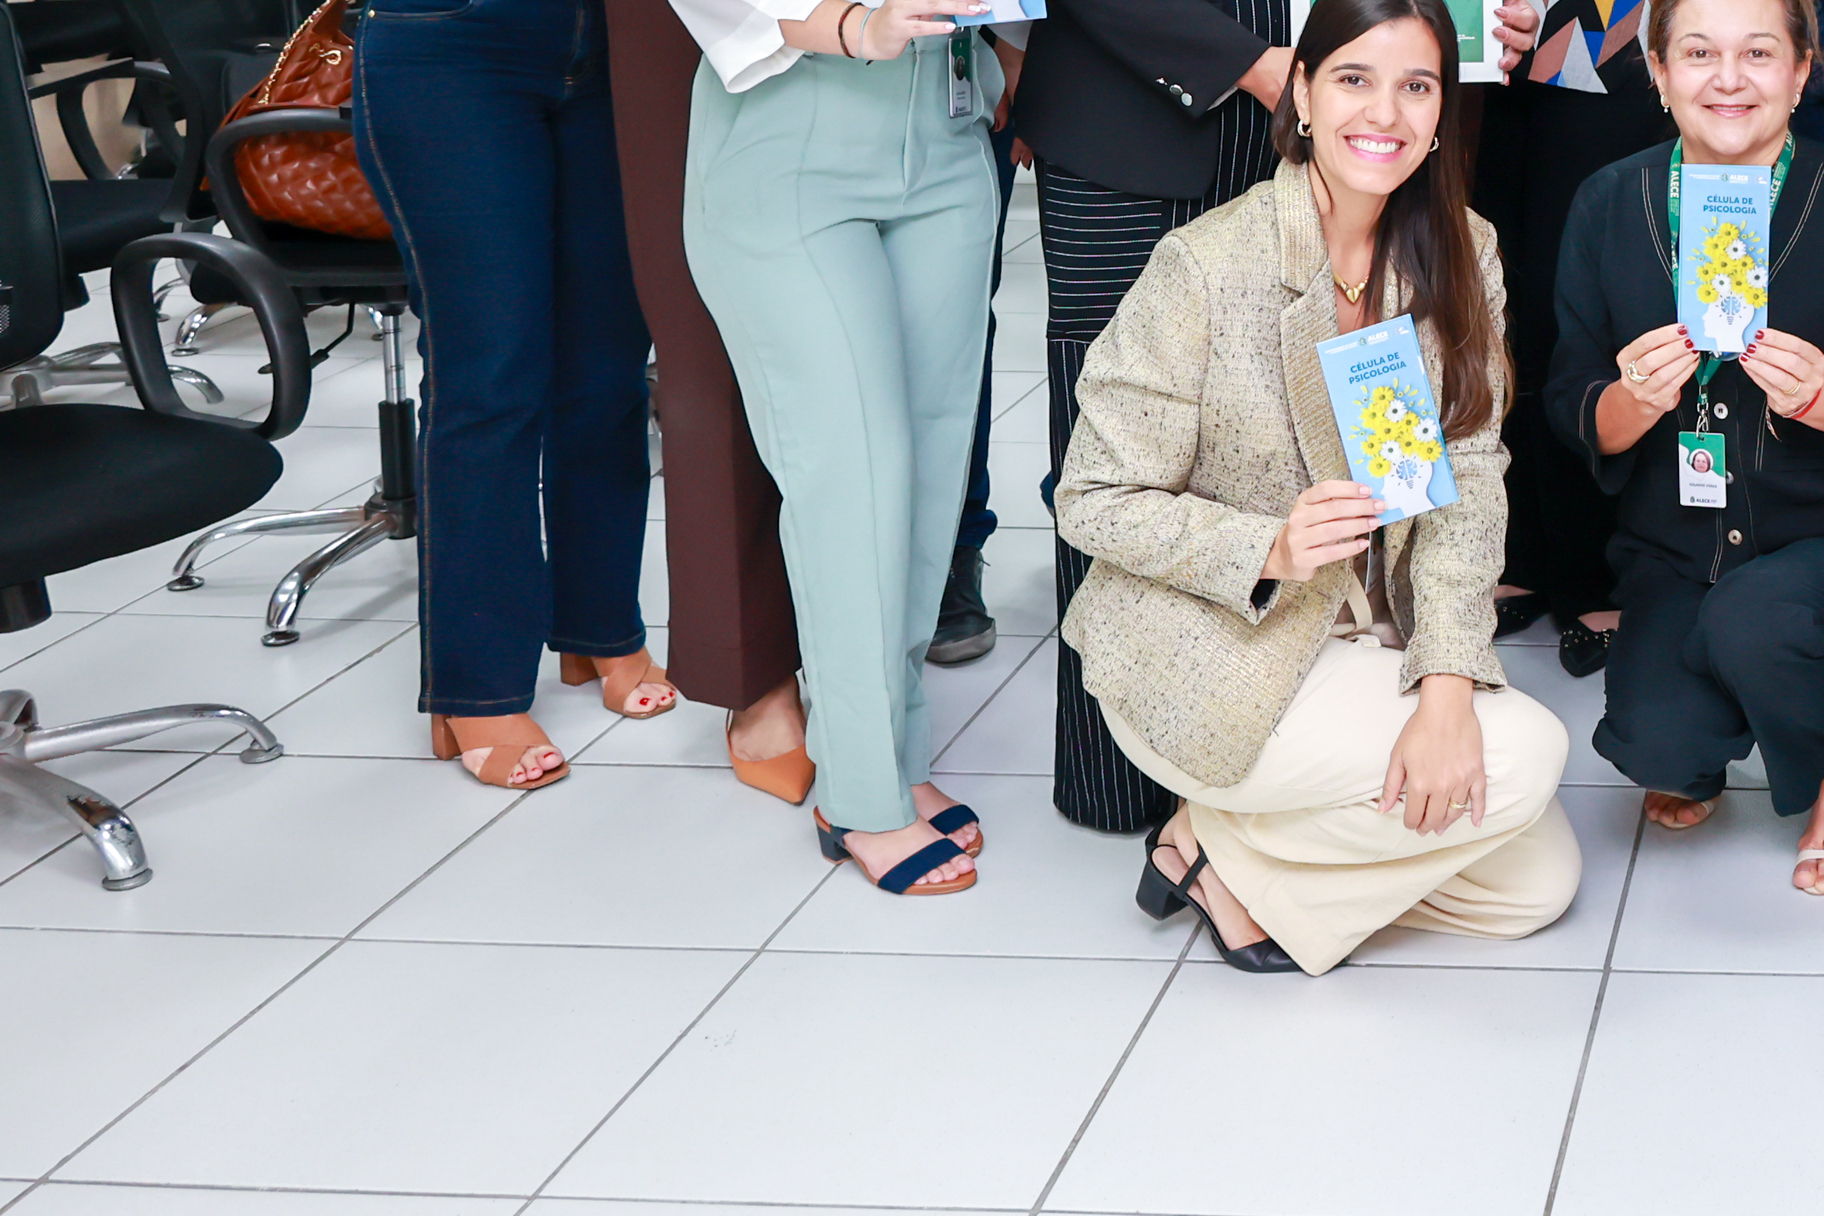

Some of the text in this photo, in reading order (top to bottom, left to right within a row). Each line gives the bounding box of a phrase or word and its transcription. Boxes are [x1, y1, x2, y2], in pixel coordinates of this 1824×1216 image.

[1670, 170, 1680, 198] ALECE
[1703, 205, 1757, 214] PSICOLOGIA
[1707, 194, 1740, 204] CÉLULA
[1349, 361, 1407, 384] PSICOLOGIA
[1350, 351, 1400, 373] CÉLULA DE
